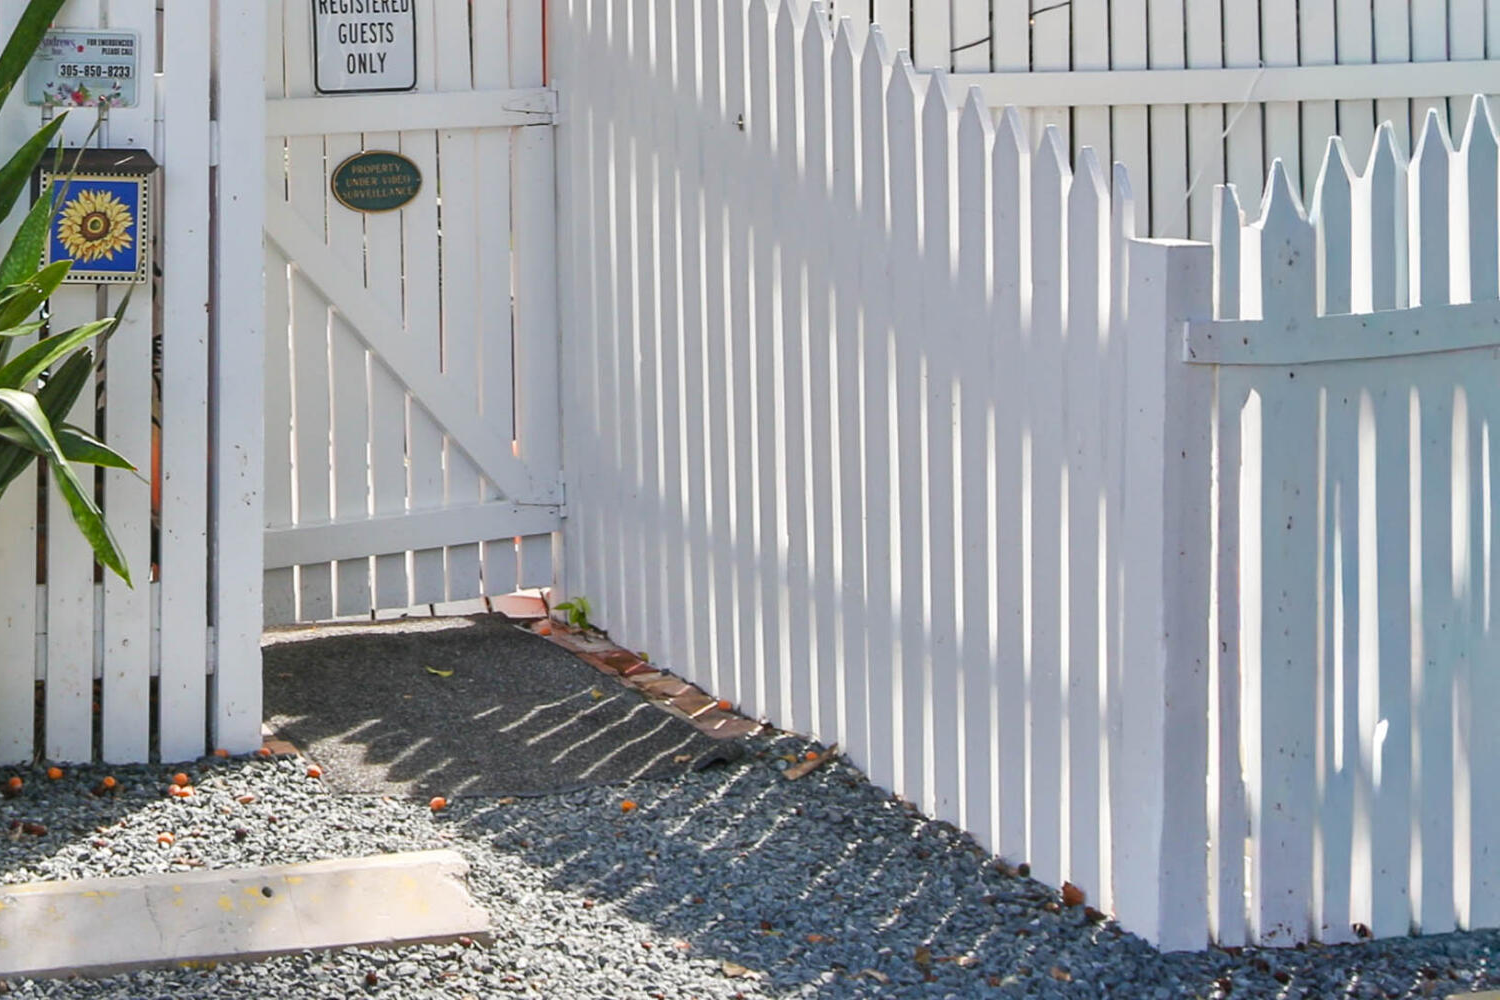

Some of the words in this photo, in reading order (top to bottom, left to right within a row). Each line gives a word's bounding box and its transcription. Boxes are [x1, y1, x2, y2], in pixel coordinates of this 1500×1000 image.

[338, 22, 394, 45] GUESTS
[347, 52, 386, 74] ONLY
[60, 64, 131, 78] 305-850-8233
[351, 163, 402, 174] PROPERTY
[346, 176, 378, 187] UNDER
[381, 175, 411, 185] VIDEO
